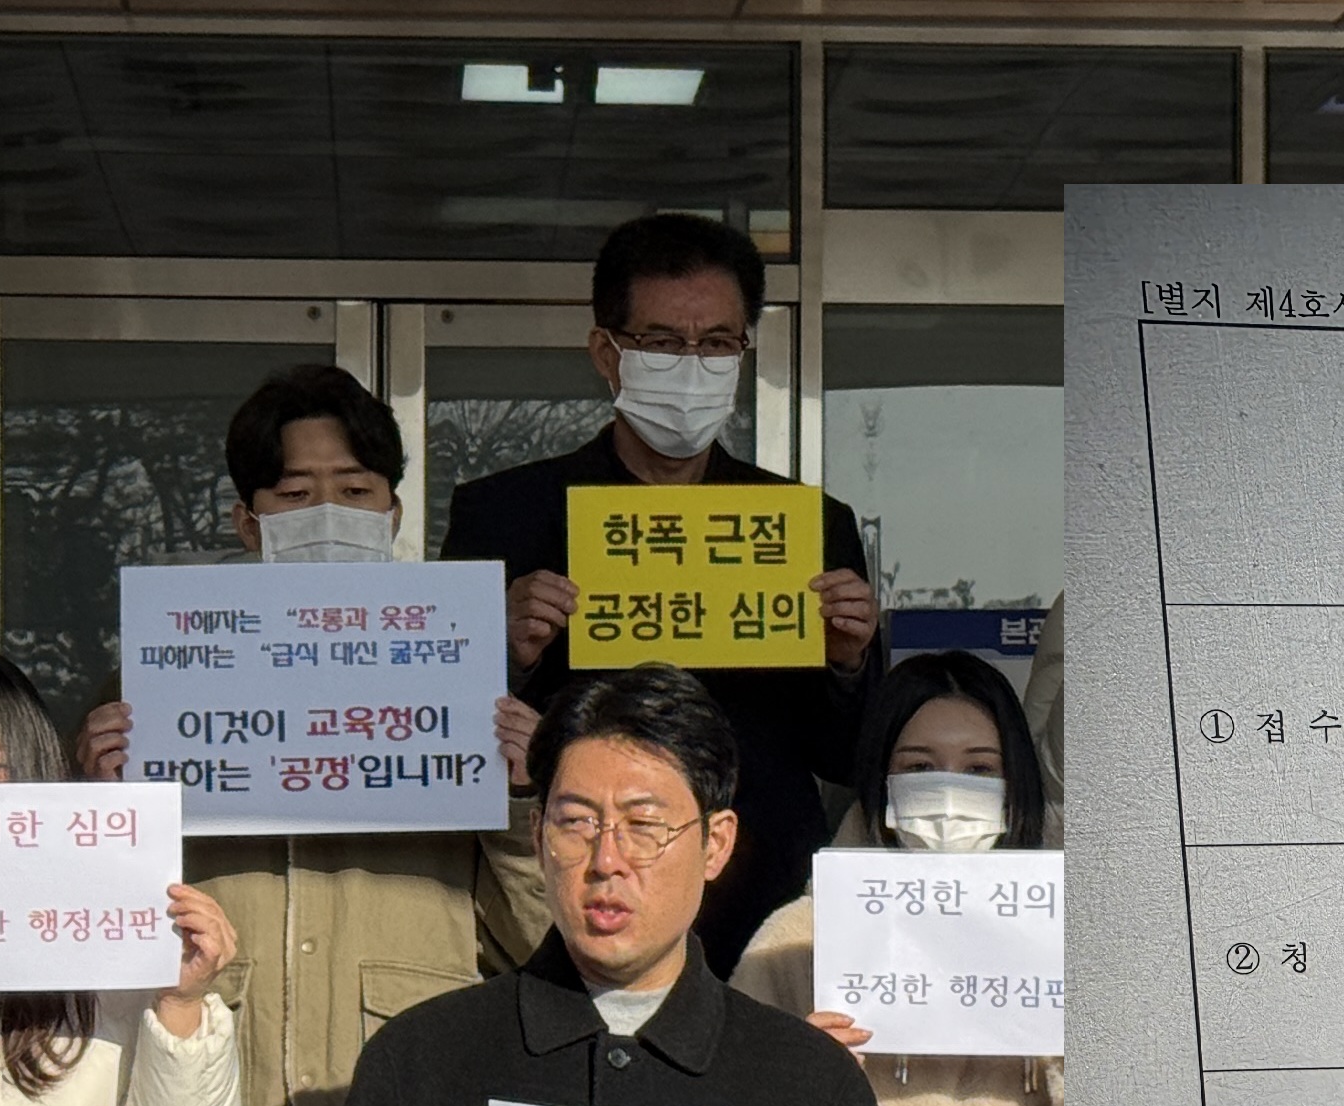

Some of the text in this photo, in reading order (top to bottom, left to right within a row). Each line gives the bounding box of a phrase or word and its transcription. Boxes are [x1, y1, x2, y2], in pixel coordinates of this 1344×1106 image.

[1141, 280, 1222, 319] [별지
[603, 512, 787, 566] 학폭 근절
[167, 609, 261, 635] 가해자는
[287, 606, 368, 632] “조롱과
[585, 591, 806, 641] 공정한 심의
[141, 643, 235, 670] 피해자는
[261, 642, 318, 667] “급식
[331, 641, 377, 665] 대신
[178, 706, 449, 744] 이것이 교육청이
[67, 808, 137, 847] 심의
[856, 879, 1055, 918] 공정한 심의
[29, 907, 161, 942] 행정심판
[837, 972, 932, 1005] 공정한
